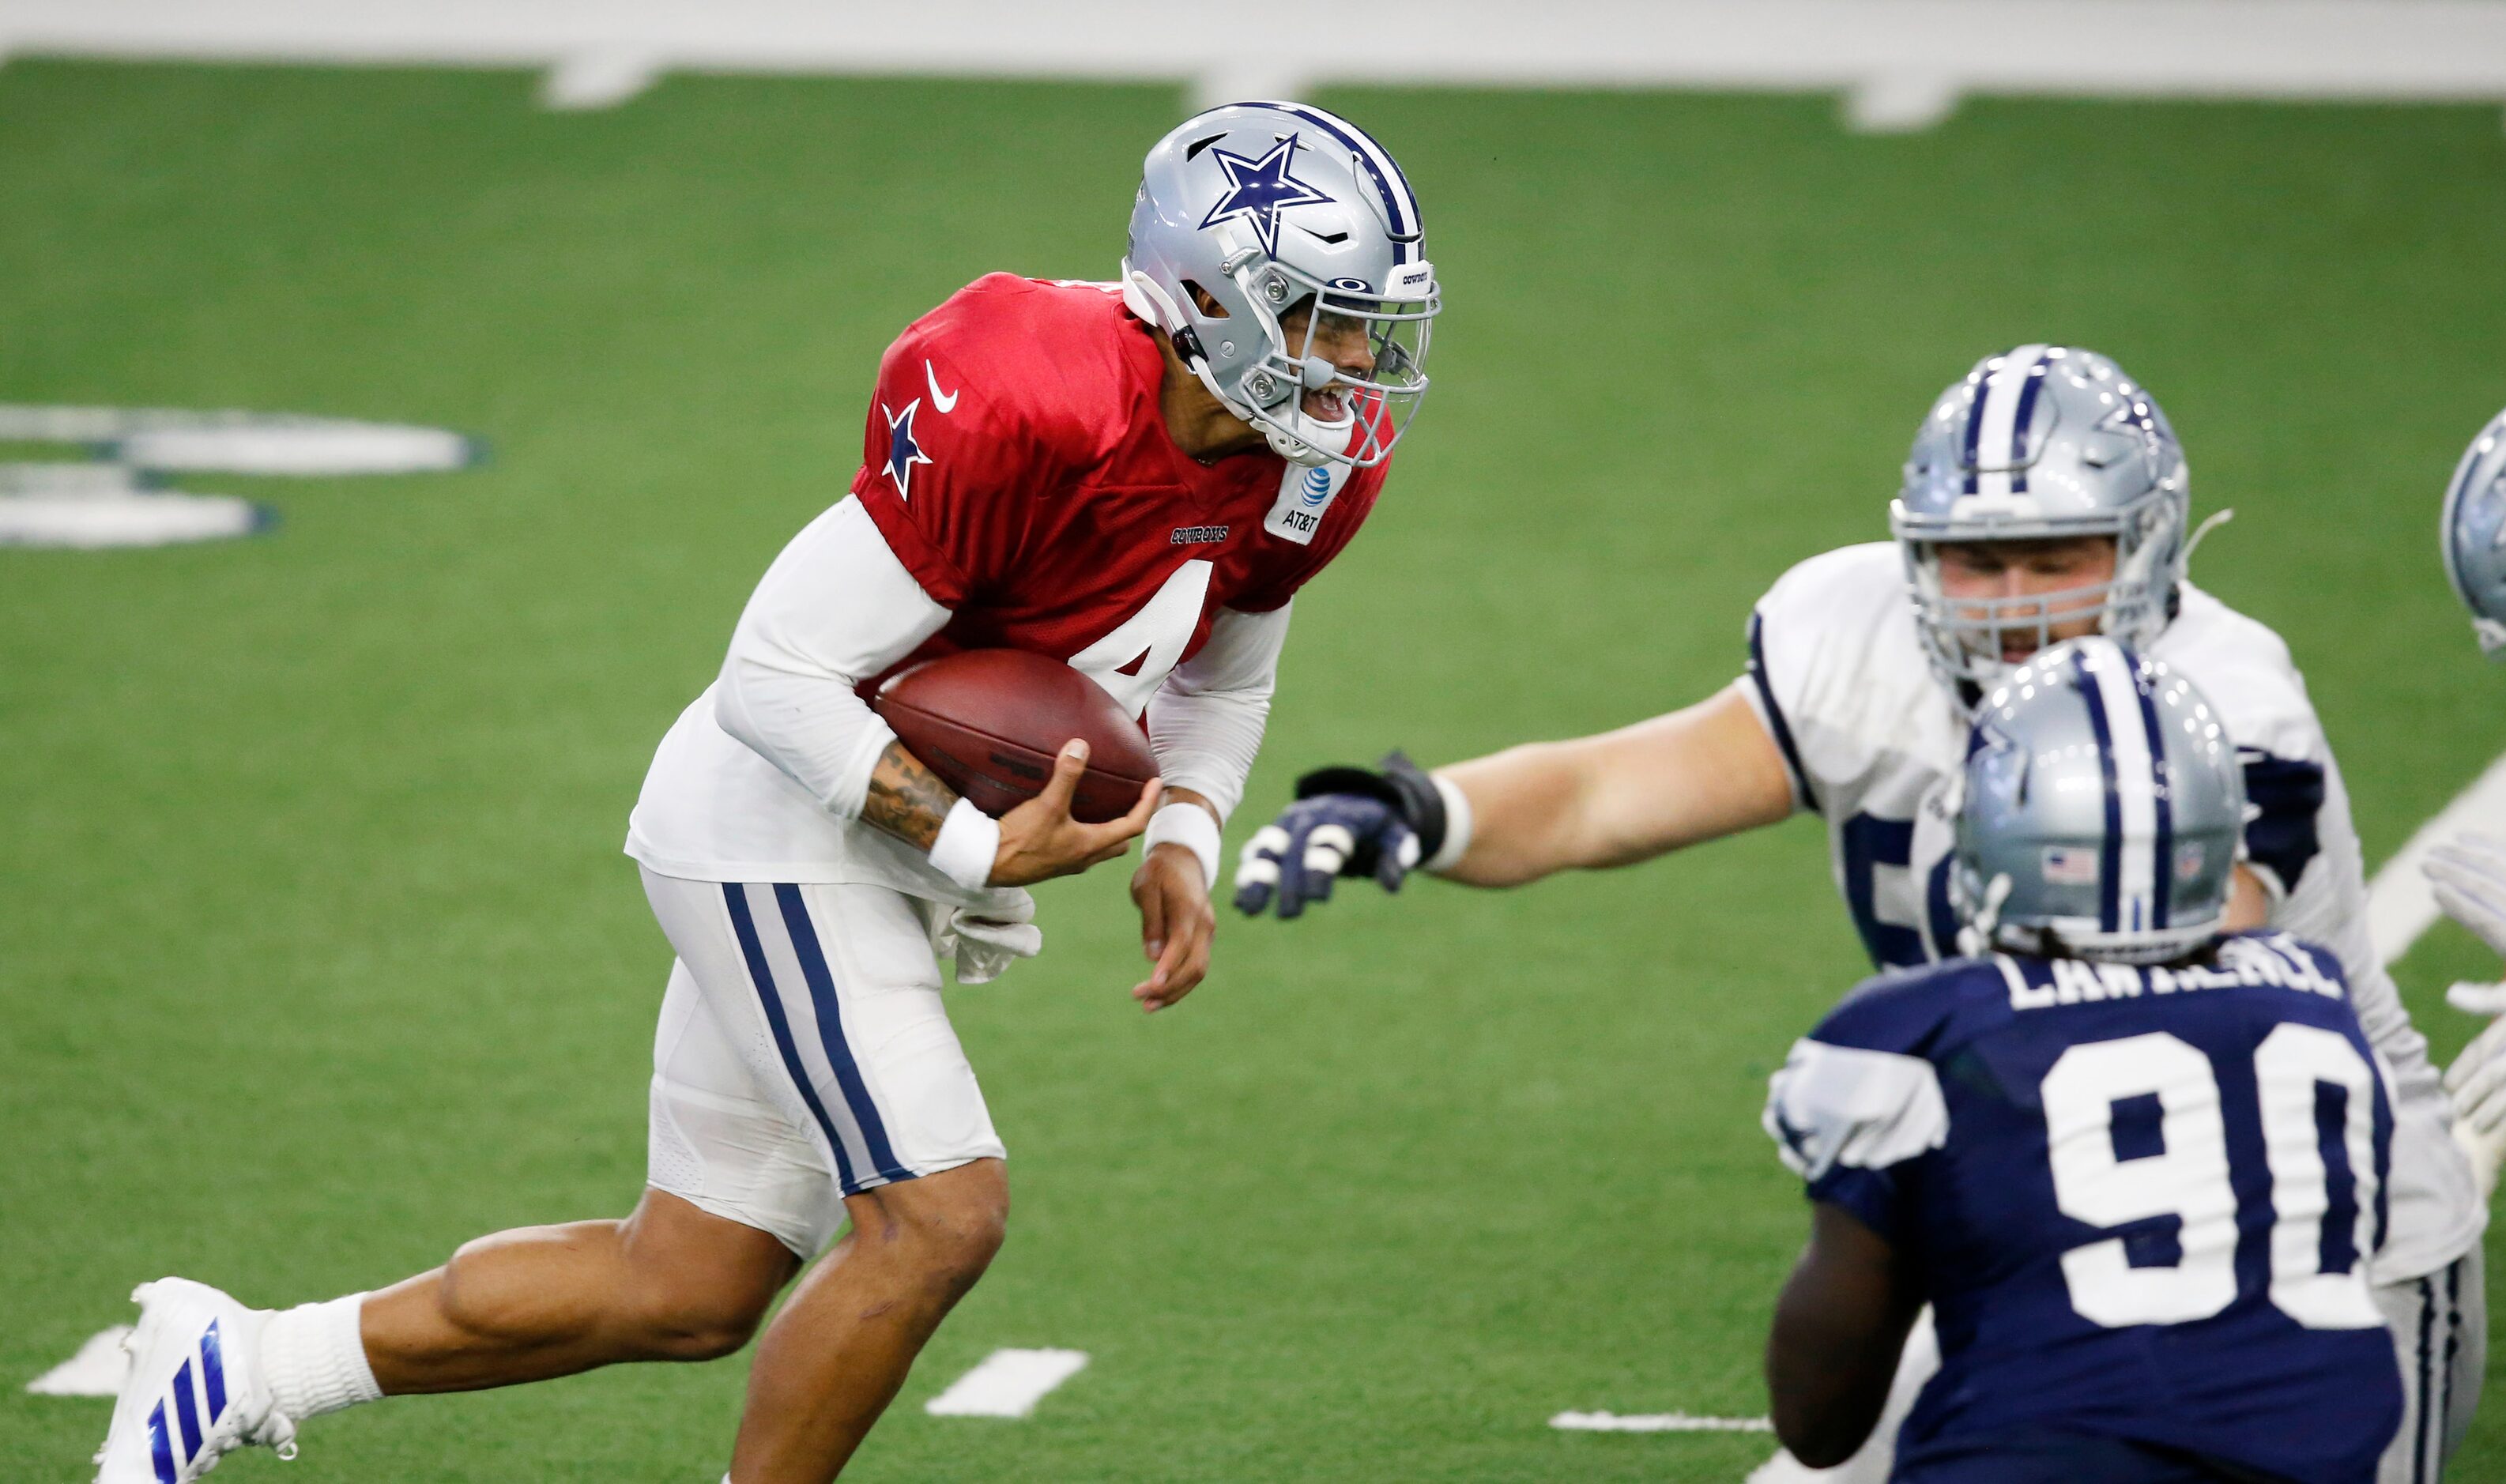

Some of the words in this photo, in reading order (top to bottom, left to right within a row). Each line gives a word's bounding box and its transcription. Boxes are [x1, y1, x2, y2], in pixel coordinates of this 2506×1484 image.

[1170, 525, 1229, 544] COWBOYS
[1283, 510, 1317, 533] AT&T
[1067, 559, 1214, 722] 4
[2040, 1022, 2387, 1330] 90
